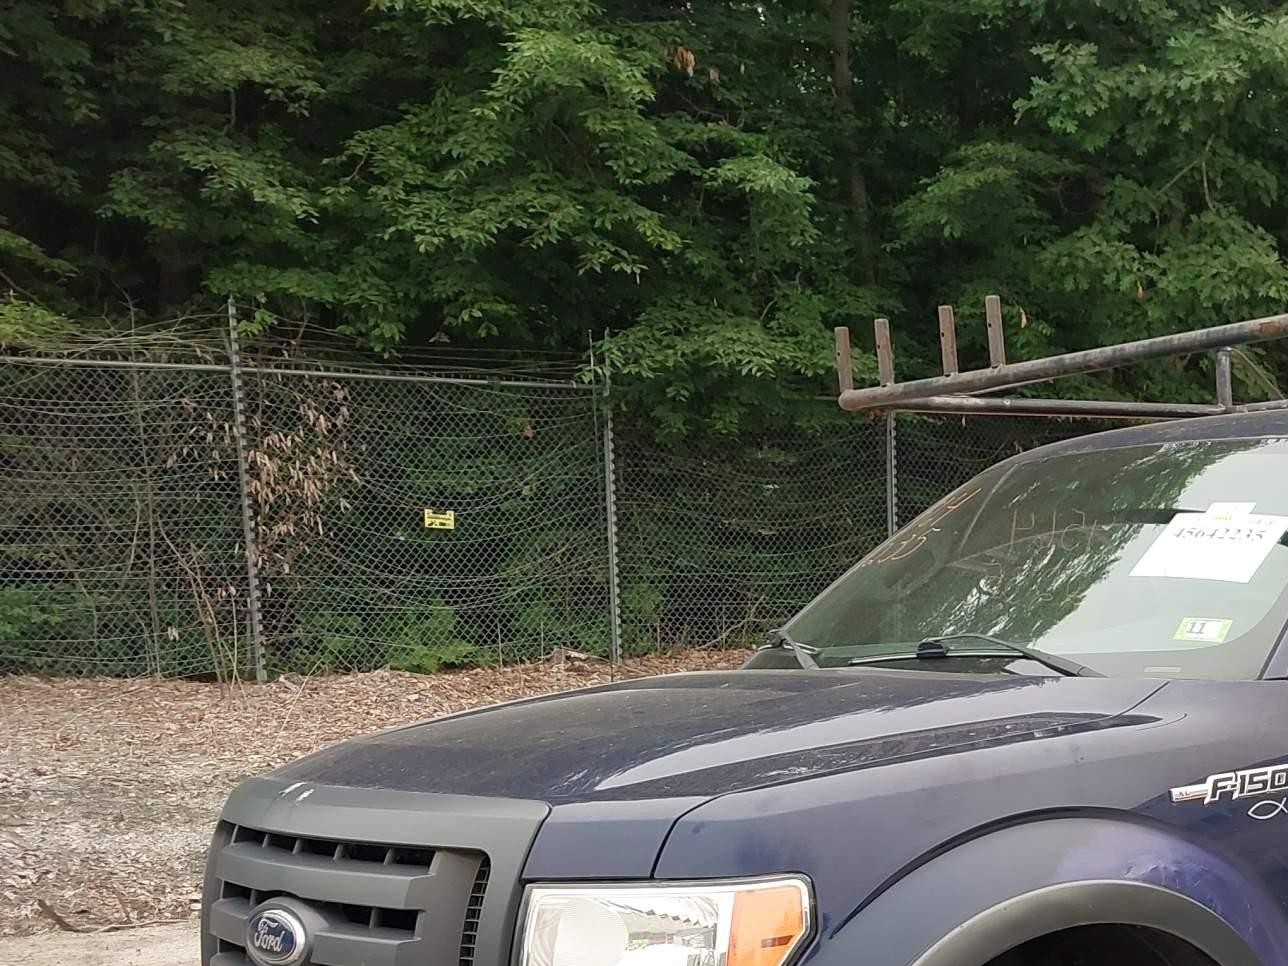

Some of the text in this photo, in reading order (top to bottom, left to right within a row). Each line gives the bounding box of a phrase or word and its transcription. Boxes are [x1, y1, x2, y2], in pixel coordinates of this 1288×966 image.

[1173, 527, 1267, 542] 45642235
[1186, 621, 1207, 635] 11
[254, 918, 286, 953] Ford
